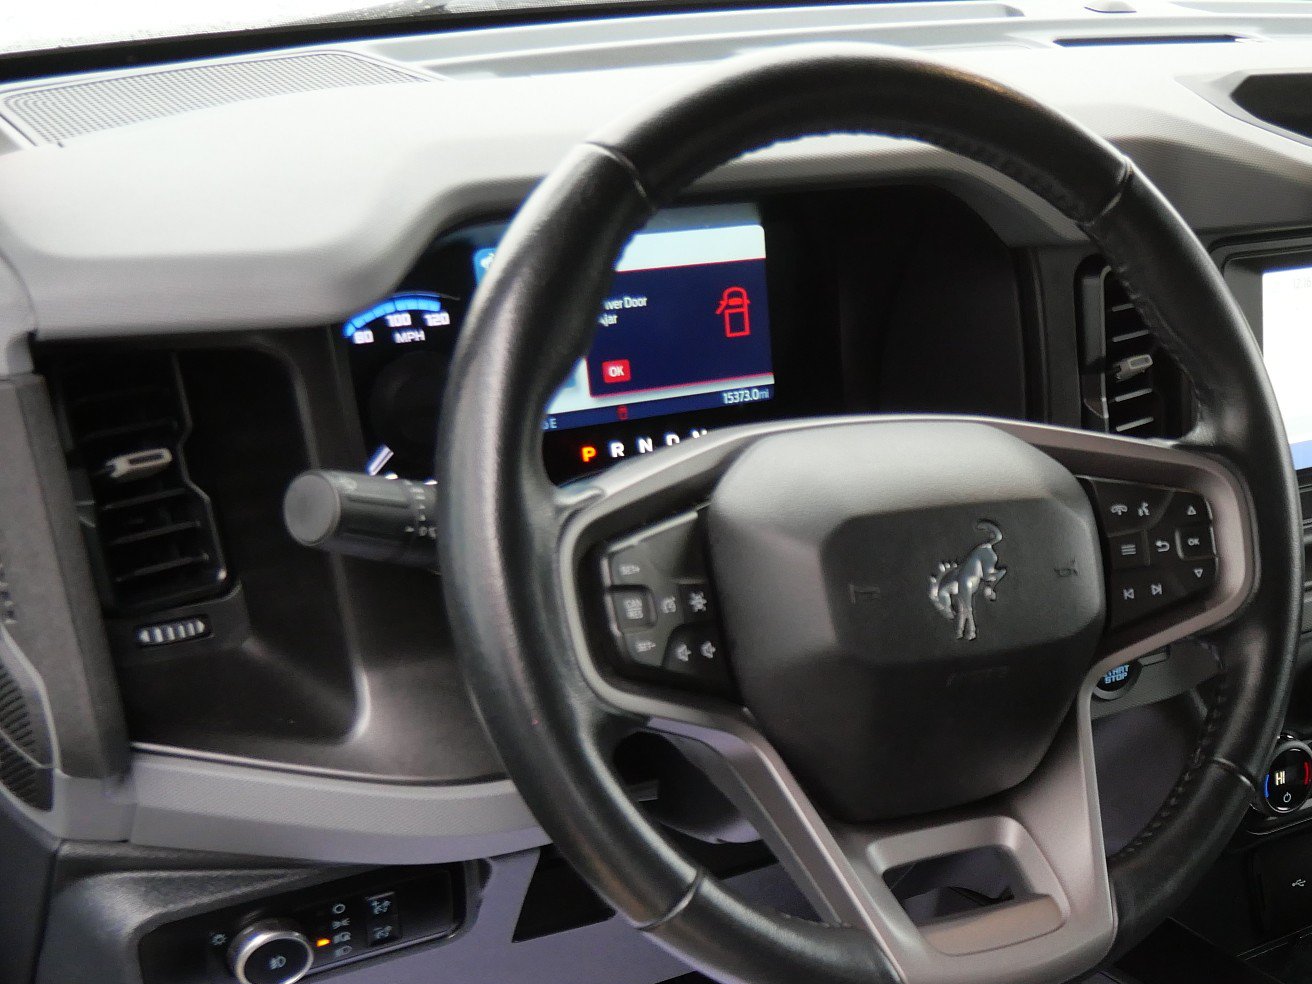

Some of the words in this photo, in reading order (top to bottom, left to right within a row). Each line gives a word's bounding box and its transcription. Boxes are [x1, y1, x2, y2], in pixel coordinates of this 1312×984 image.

[623, 296, 647, 309] Door
[386, 312, 412, 328] 100
[424, 312, 451, 327] 120
[394, 328, 426, 344] MPH
[608, 365, 625, 378] OK
[581, 445, 597, 463] P
[610, 442, 626, 458] R
[638, 437, 654, 454] N
[1104, 672, 1128, 684] STOP
[1275, 770, 1286, 786] HI
